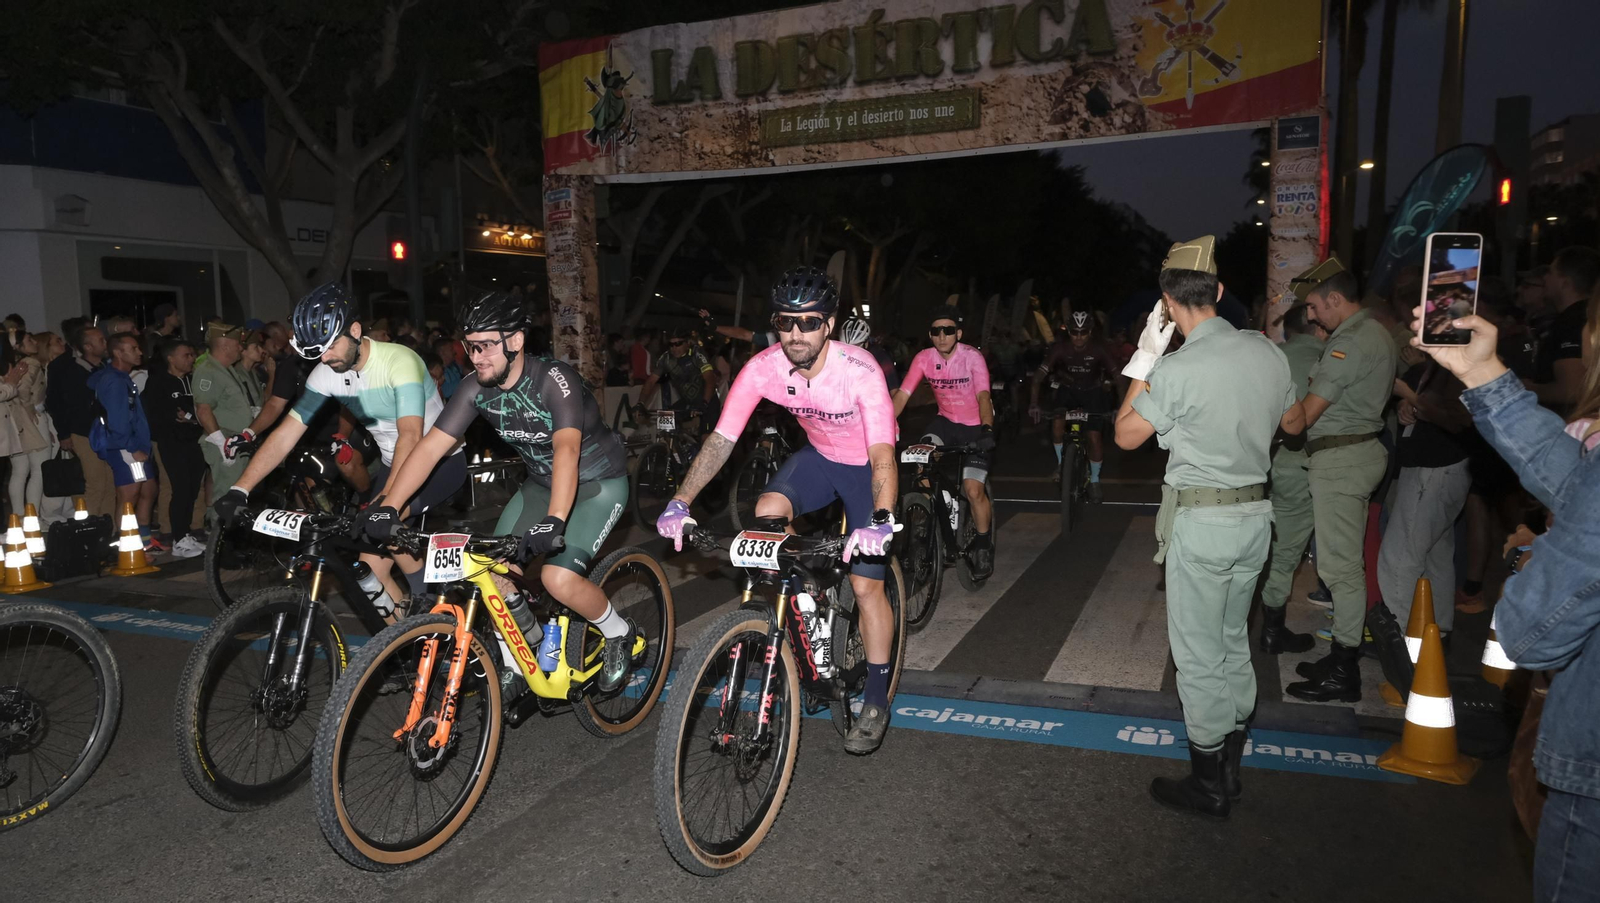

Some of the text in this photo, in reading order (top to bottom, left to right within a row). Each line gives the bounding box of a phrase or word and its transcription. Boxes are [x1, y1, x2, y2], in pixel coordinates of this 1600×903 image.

[650, 0, 1116, 106] LA DESÉRTICA
[779, 105, 956, 134] La Legión y el desierto nos une
[1276, 191, 1317, 204] RENTA
[1277, 184, 1316, 193] GRUPO
[846, 355, 876, 374] agrogestia
[547, 366, 572, 399] ŠKODA
[265, 508, 302, 530] 8215
[592, 502, 623, 552] ORBEA
[433, 547, 462, 569] 6545
[736, 538, 776, 559] 8338
[487, 594, 538, 676] ORBEA
[440, 689, 460, 724] FOX
[895, 706, 1065, 732] cajamar
[970, 722, 1056, 738] CAJA RURAL
[1242, 737, 1382, 766] jamar
[1283, 756, 1327, 766] CAJA
[0, 800, 50, 827] MAXXI
